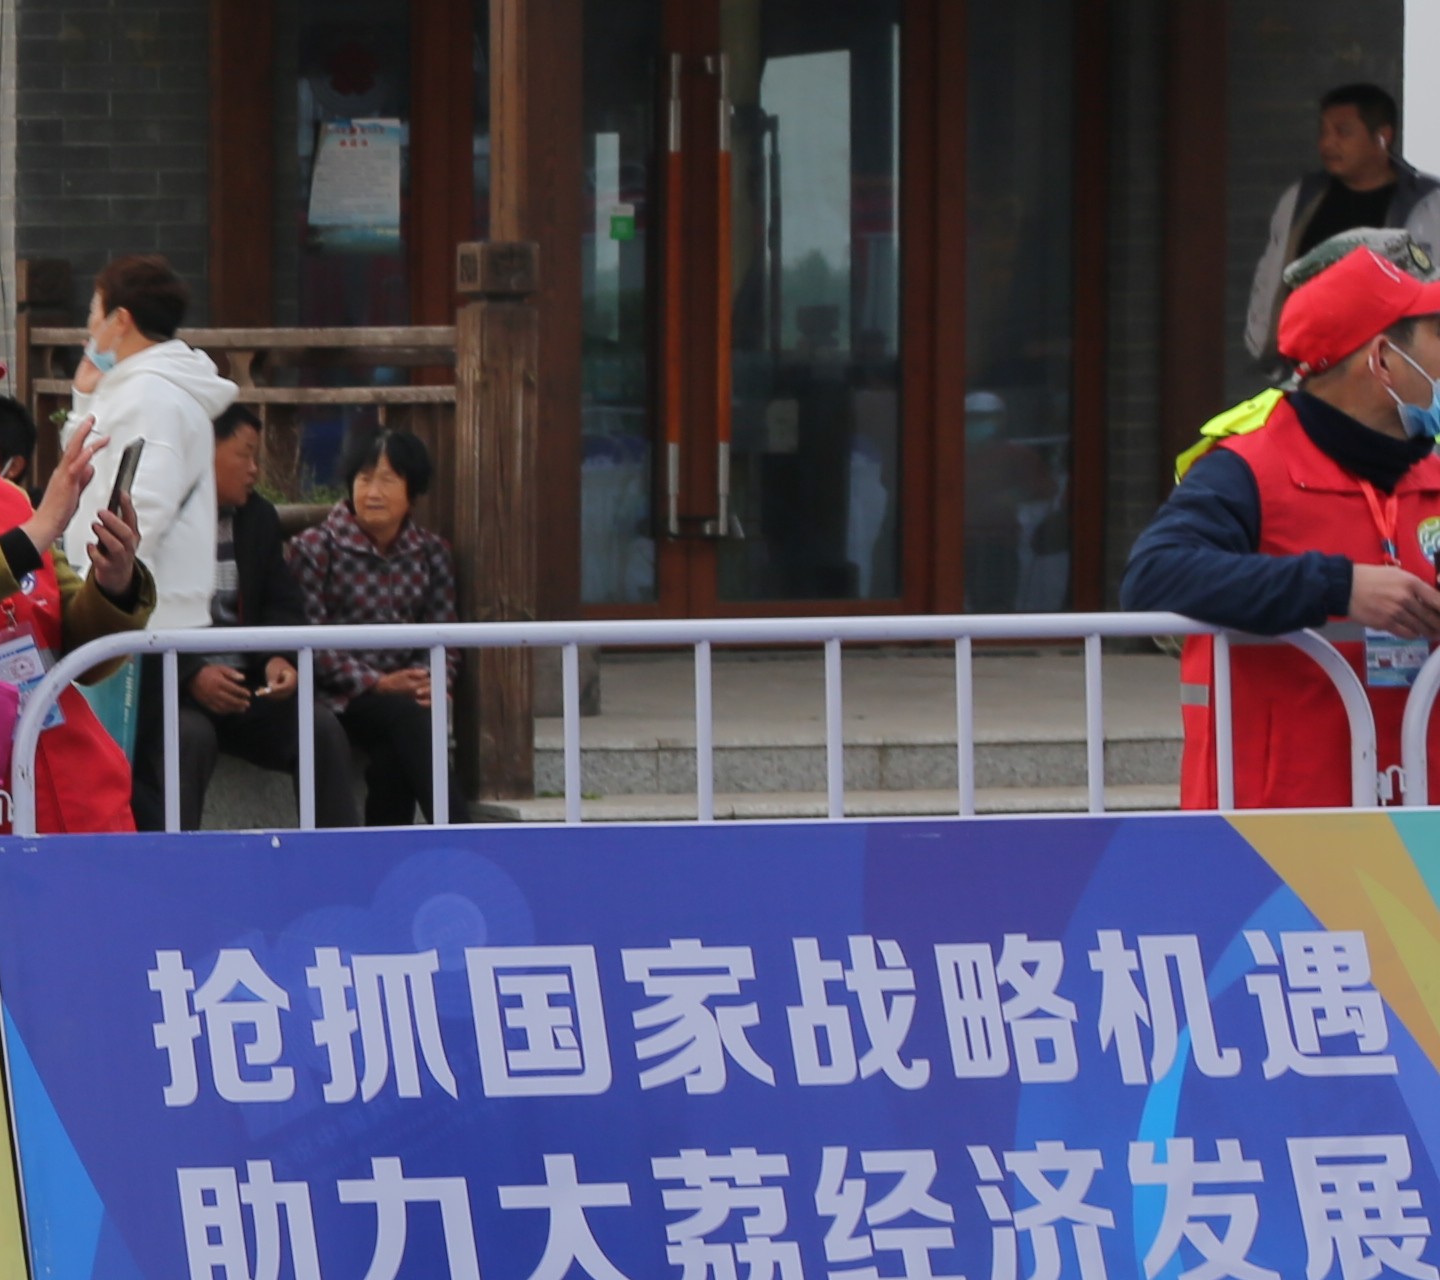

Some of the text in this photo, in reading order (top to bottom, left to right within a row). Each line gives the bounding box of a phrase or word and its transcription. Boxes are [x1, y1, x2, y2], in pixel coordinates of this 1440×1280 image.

[147, 929, 1399, 1107] 抢抓国家战略机遇
